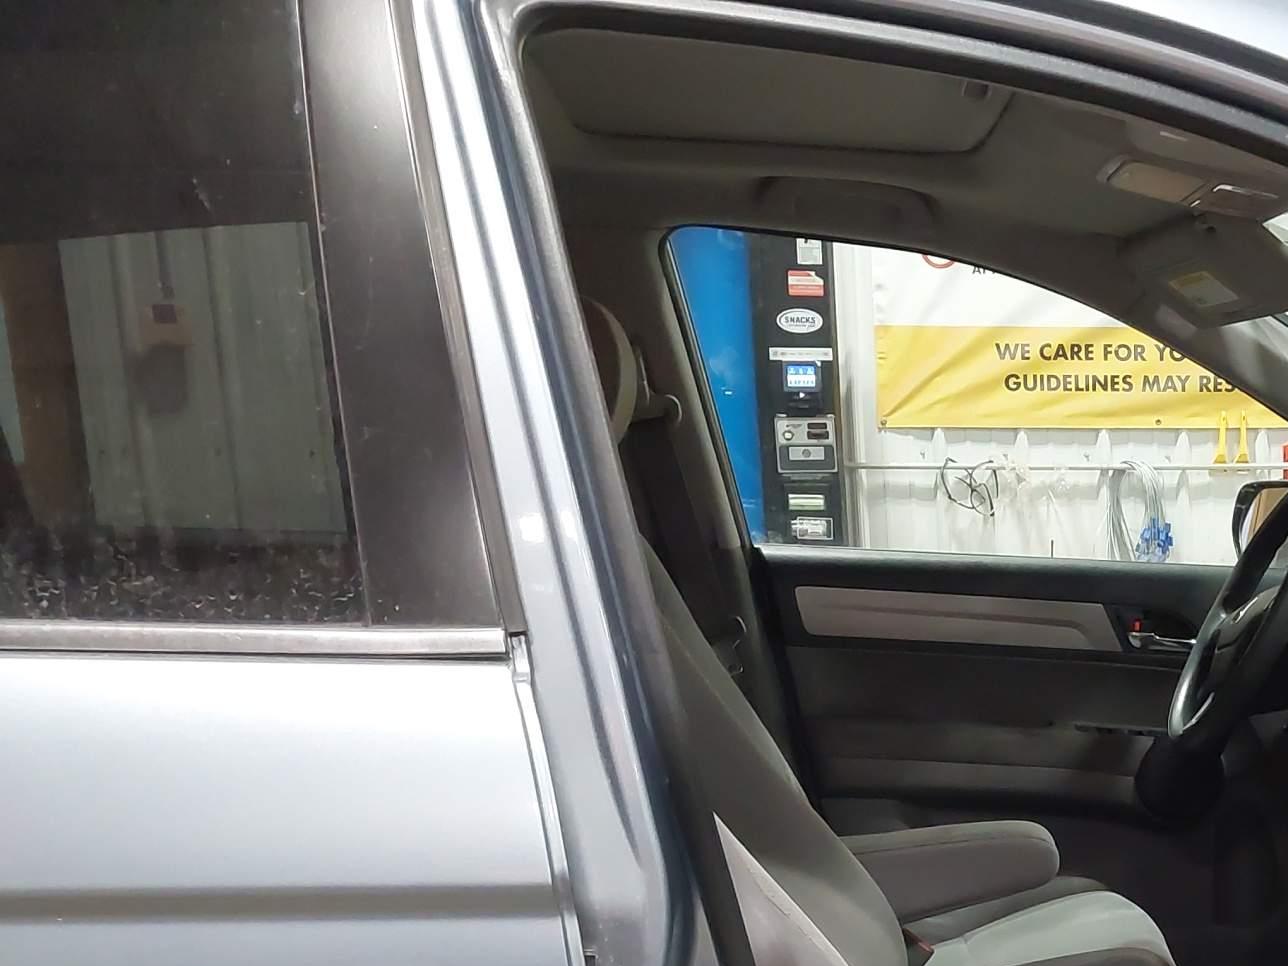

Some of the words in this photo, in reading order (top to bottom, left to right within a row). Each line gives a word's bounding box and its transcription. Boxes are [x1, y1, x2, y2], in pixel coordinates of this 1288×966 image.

[784, 316, 815, 324] SNACKS
[995, 343, 1031, 360] WE
[1039, 343, 1094, 361] CARE
[1103, 344, 1147, 361] FOR
[1004, 373, 1134, 392] GUIDELINES
[1141, 374, 1191, 392] MAY
